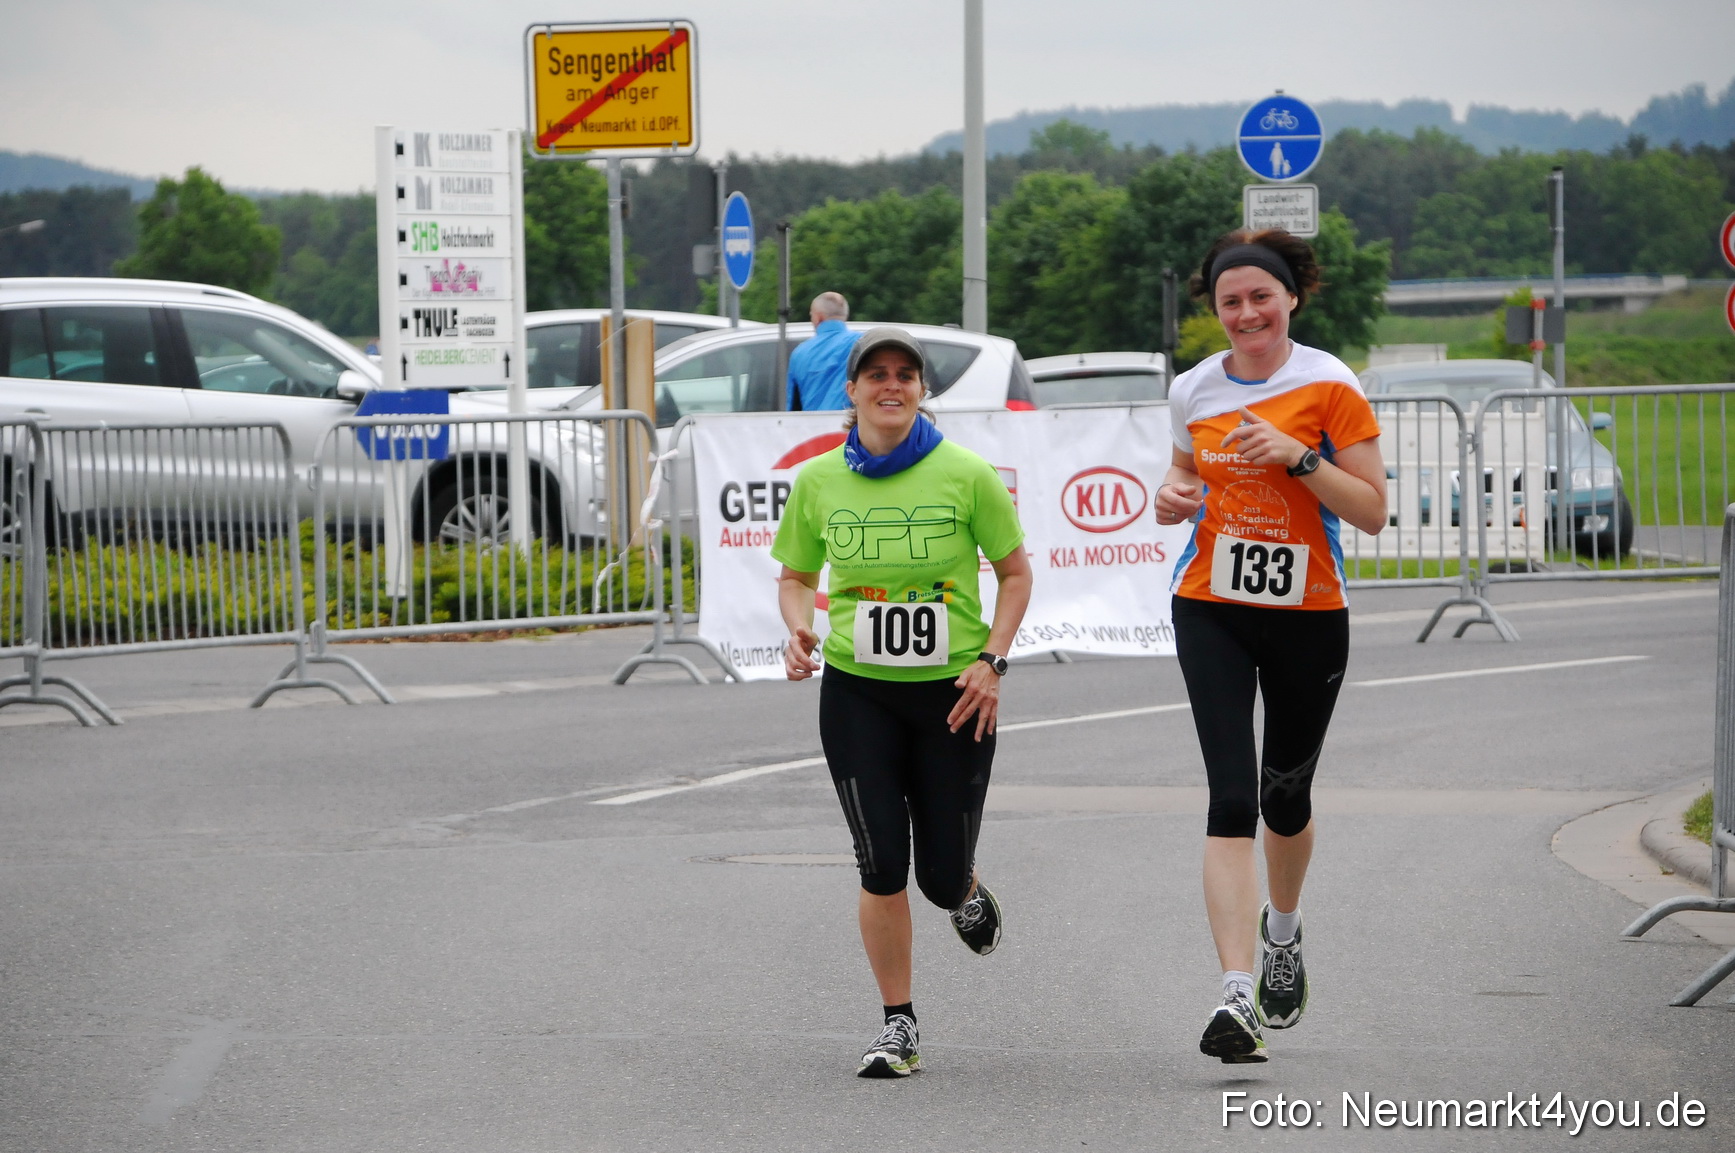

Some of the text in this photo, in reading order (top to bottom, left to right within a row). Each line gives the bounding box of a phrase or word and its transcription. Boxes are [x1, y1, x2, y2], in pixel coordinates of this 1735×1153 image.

[548, 43, 676, 82] Sengenthal
[566, 84, 659, 104] am Anger
[546, 120, 575, 134] Kreis
[580, 118, 637, 133] Neumarkt
[413, 307, 458, 337] THULE
[1076, 483, 1131, 517] KIA
[1222, 523, 1289, 539] Nürnberg
[1237, 514, 1285, 524] Stadtlauf
[1050, 548, 1078, 567] KIA
[1085, 542, 1166, 566] MOTORS
[1230, 542, 1294, 597] 133
[868, 606, 936, 657] 109
